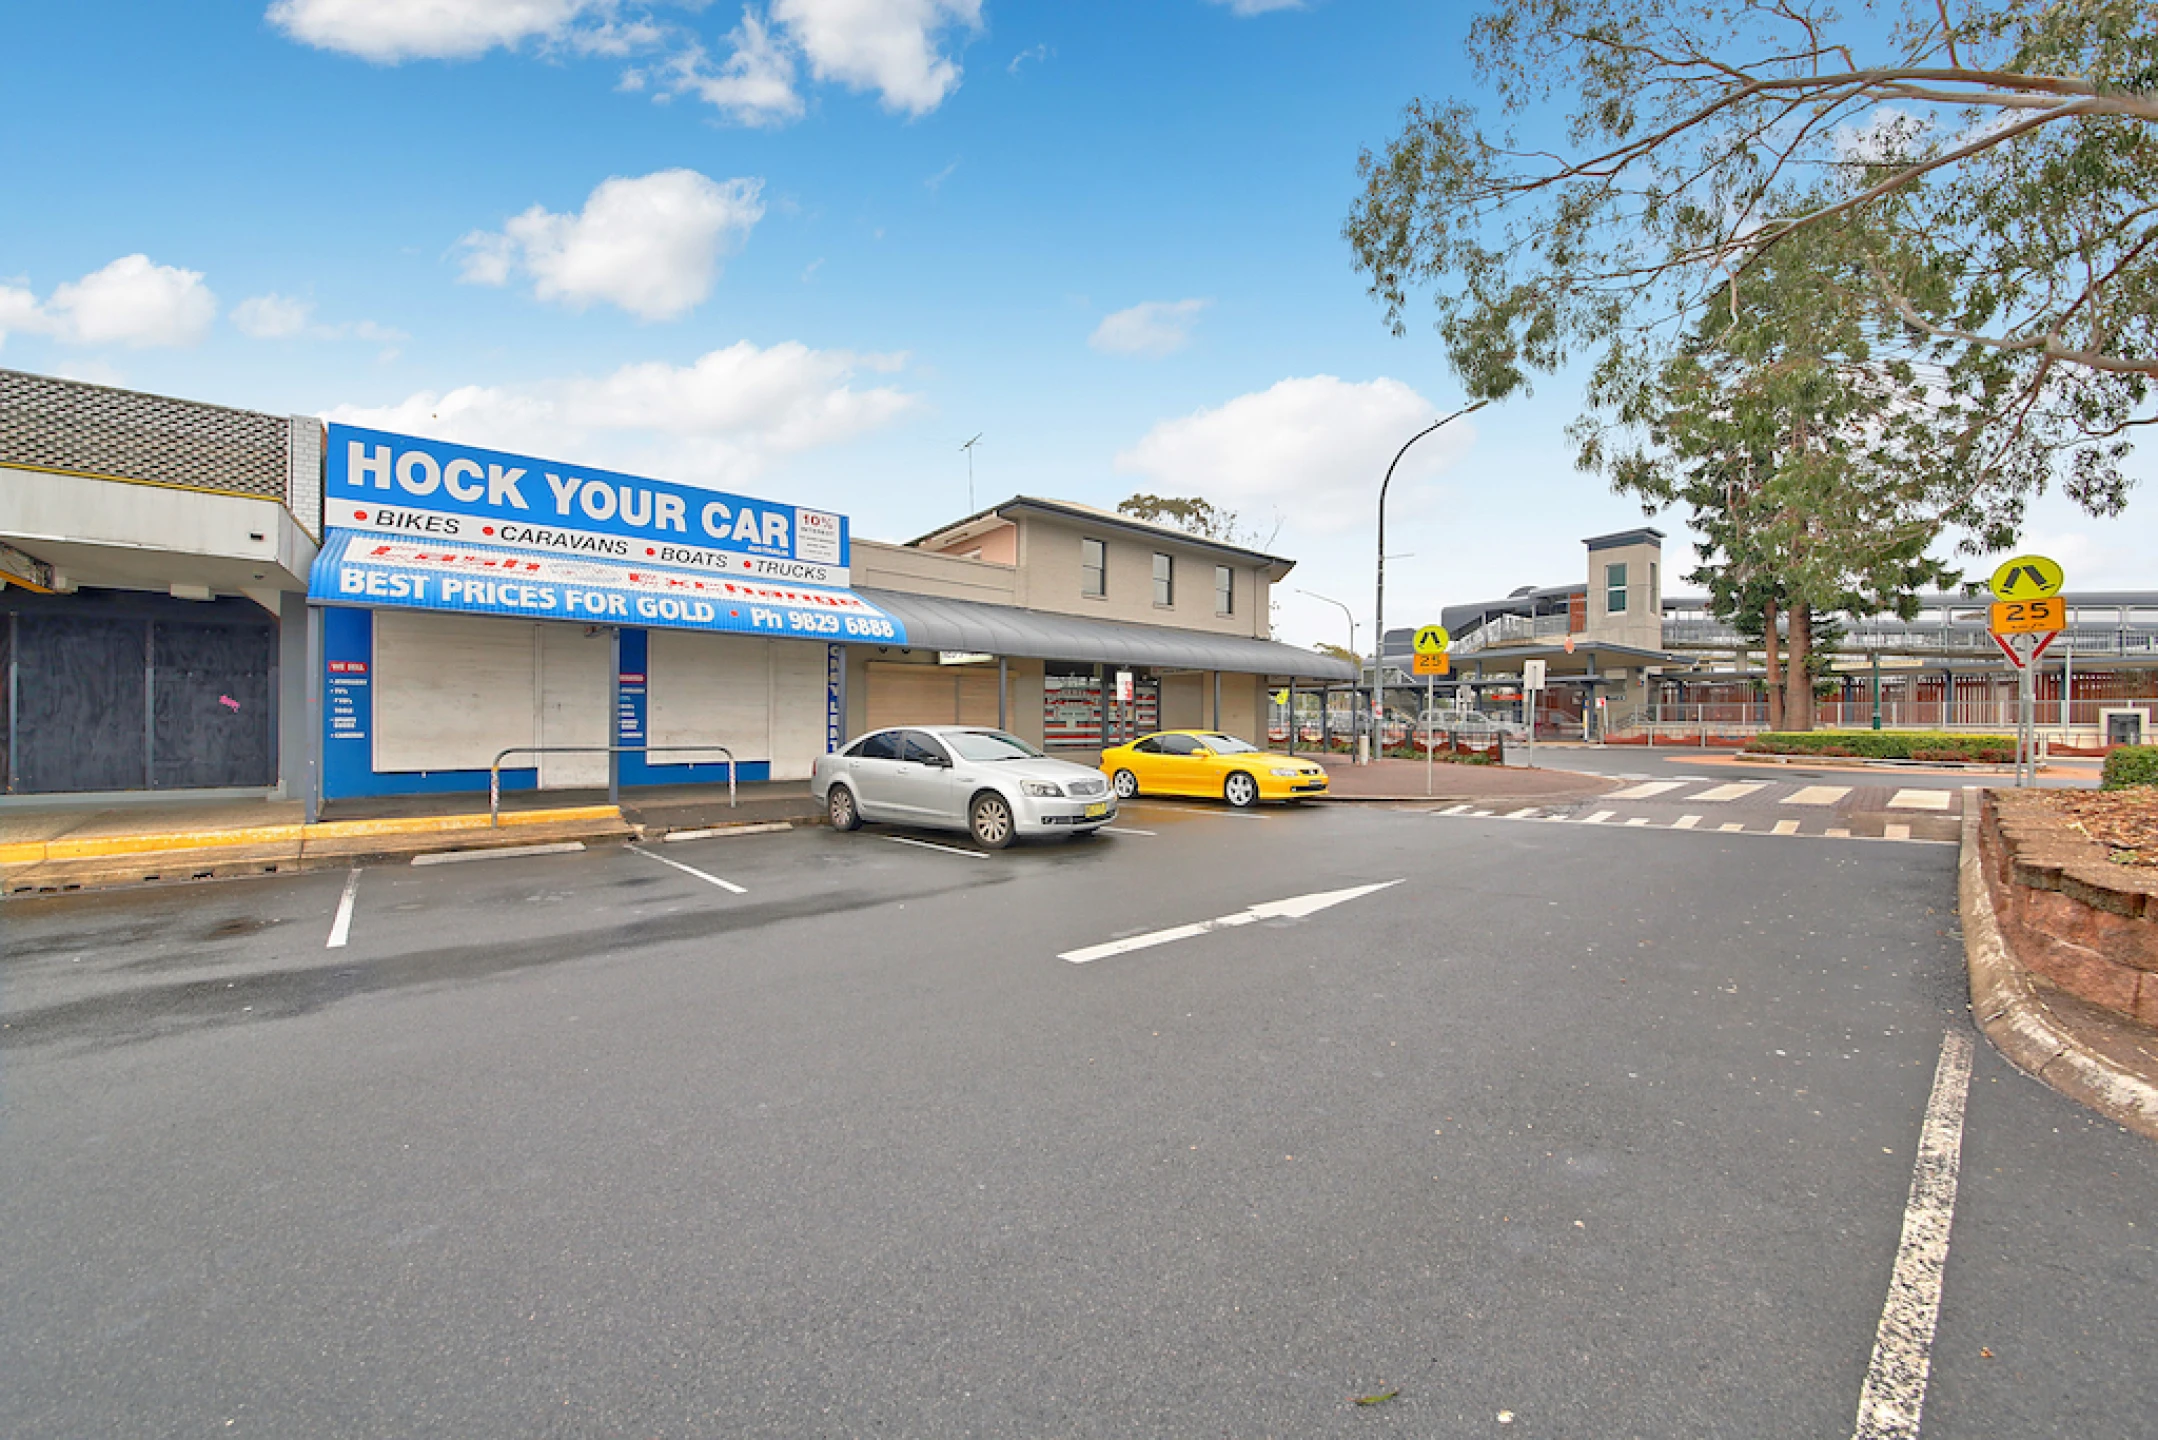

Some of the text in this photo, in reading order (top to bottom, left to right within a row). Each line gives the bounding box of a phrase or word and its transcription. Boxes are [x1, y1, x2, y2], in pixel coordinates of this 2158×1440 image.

[347, 440, 789, 549] HOCK YOUR CAR
[374, 509, 461, 535] BIKES
[803, 513, 834, 530] 10%
[500, 525, 629, 556] CARAVANS
[660, 546, 728, 569] BOATS
[756, 559, 827, 581] TRUCKS
[339, 567, 895, 639] BEST PRICES FOR GOLD Ph 9829 6888
[2006, 602, 2050, 622] 25
[1420, 655, 1442, 667] 25
